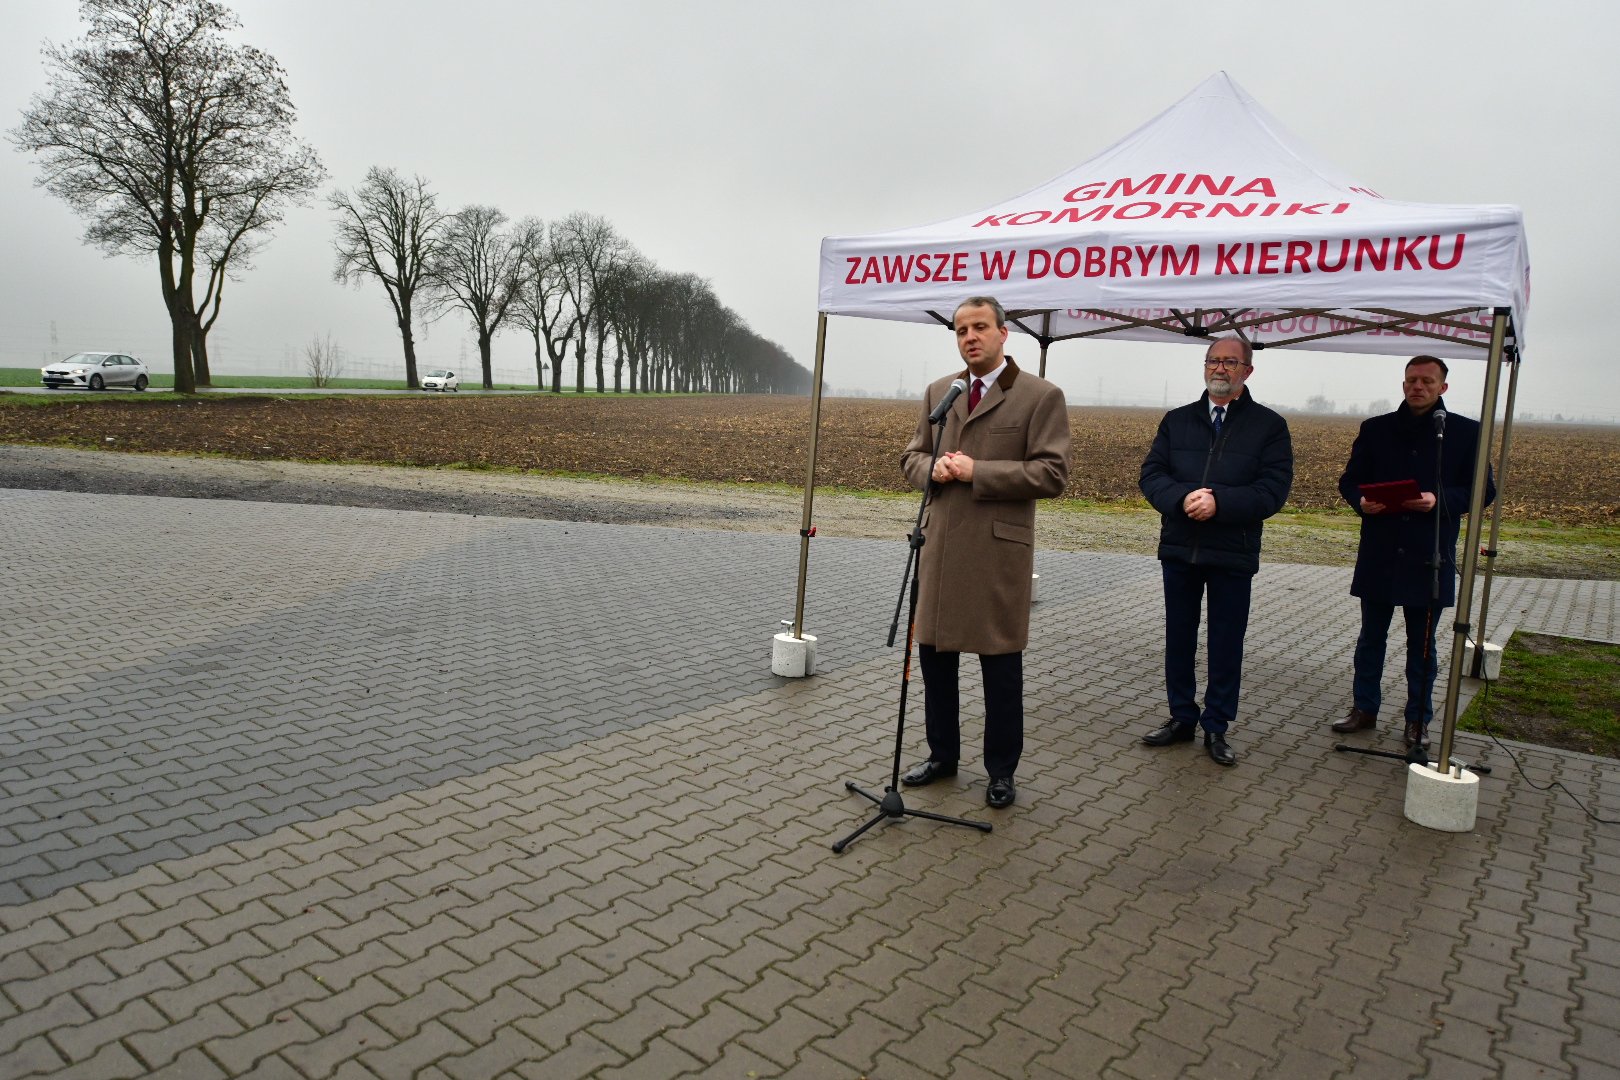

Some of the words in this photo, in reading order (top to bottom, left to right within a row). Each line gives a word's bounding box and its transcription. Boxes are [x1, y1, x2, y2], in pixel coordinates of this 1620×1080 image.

[1063, 173, 1277, 203] GMINA
[972, 201, 1351, 228] KOMORNIKI
[845, 253, 970, 285] ZAWSZE
[979, 249, 1017, 281] W
[1026, 244, 1201, 280] DOBRYM
[1214, 233, 1467, 276] KIERUNKU
